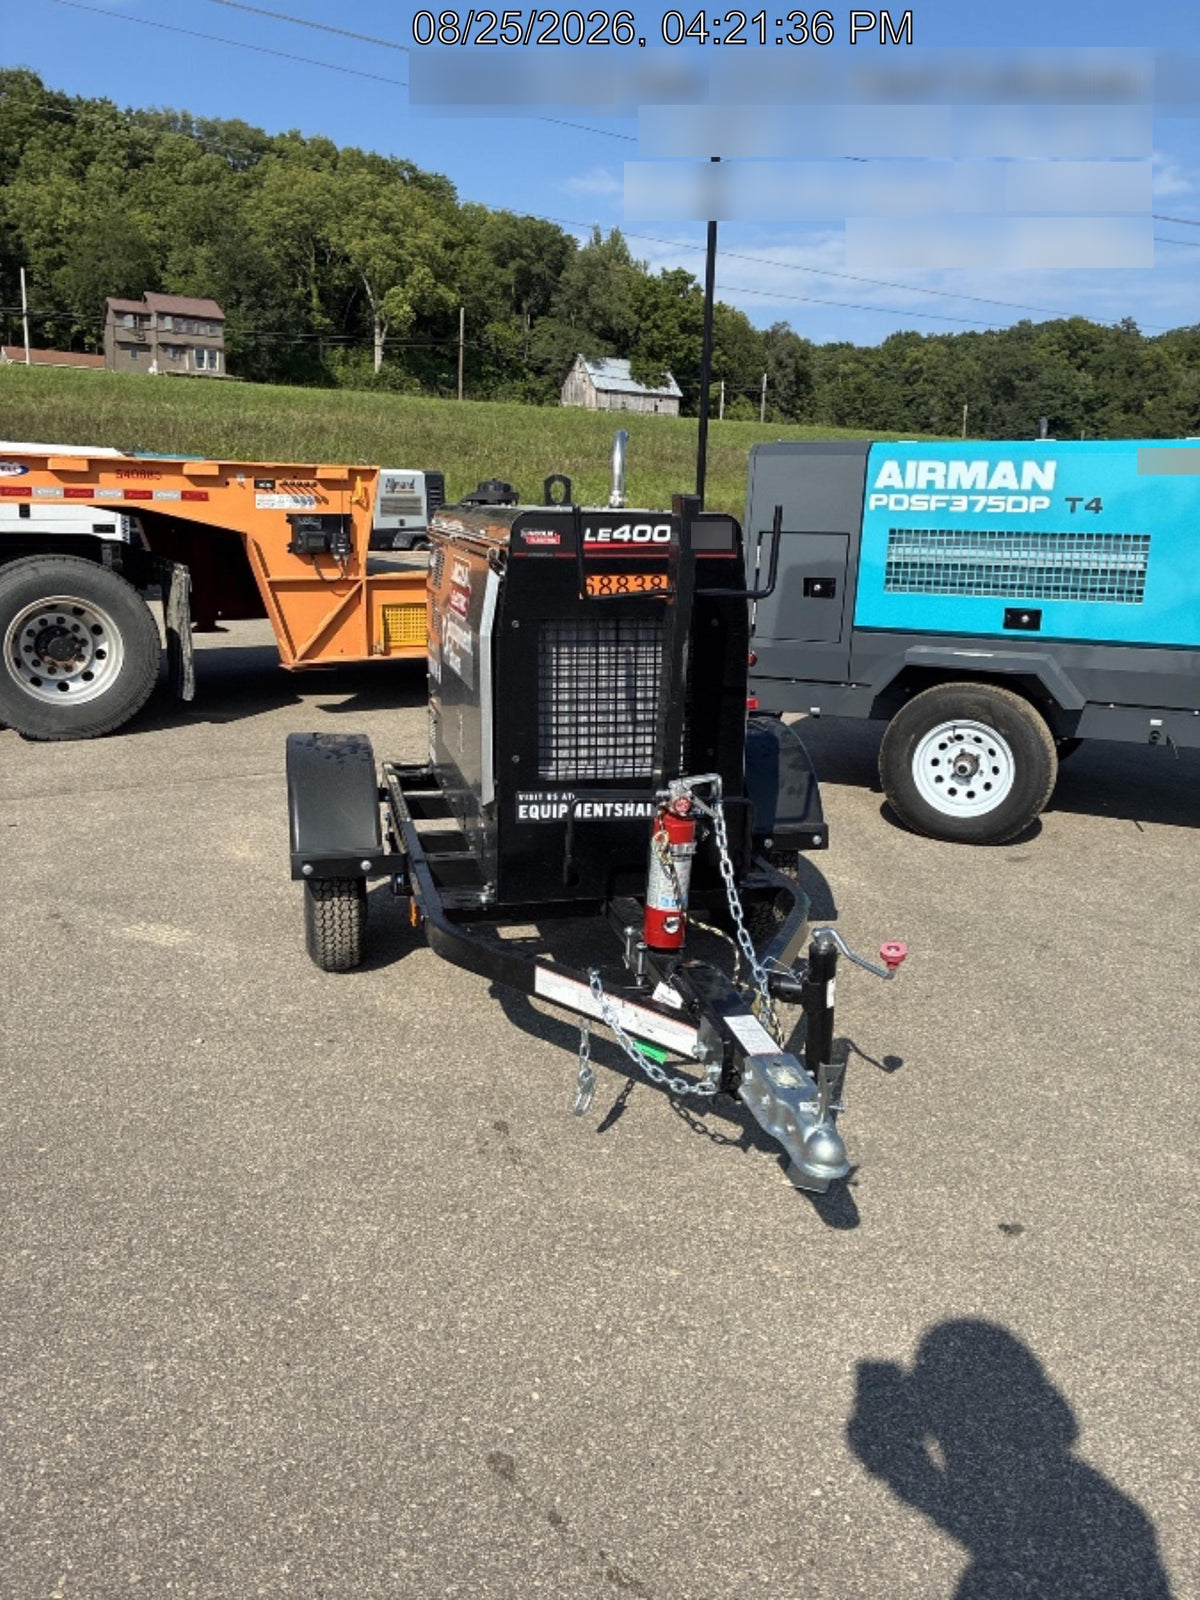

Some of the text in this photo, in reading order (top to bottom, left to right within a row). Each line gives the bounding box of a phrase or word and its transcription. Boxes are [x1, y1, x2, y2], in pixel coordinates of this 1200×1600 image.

[874, 460, 1057, 490] AIRMAN
[869, 494, 1103, 514] PDSF375DP T4
[584, 524, 672, 543] LE400
[518, 793, 543, 801] VISIT
